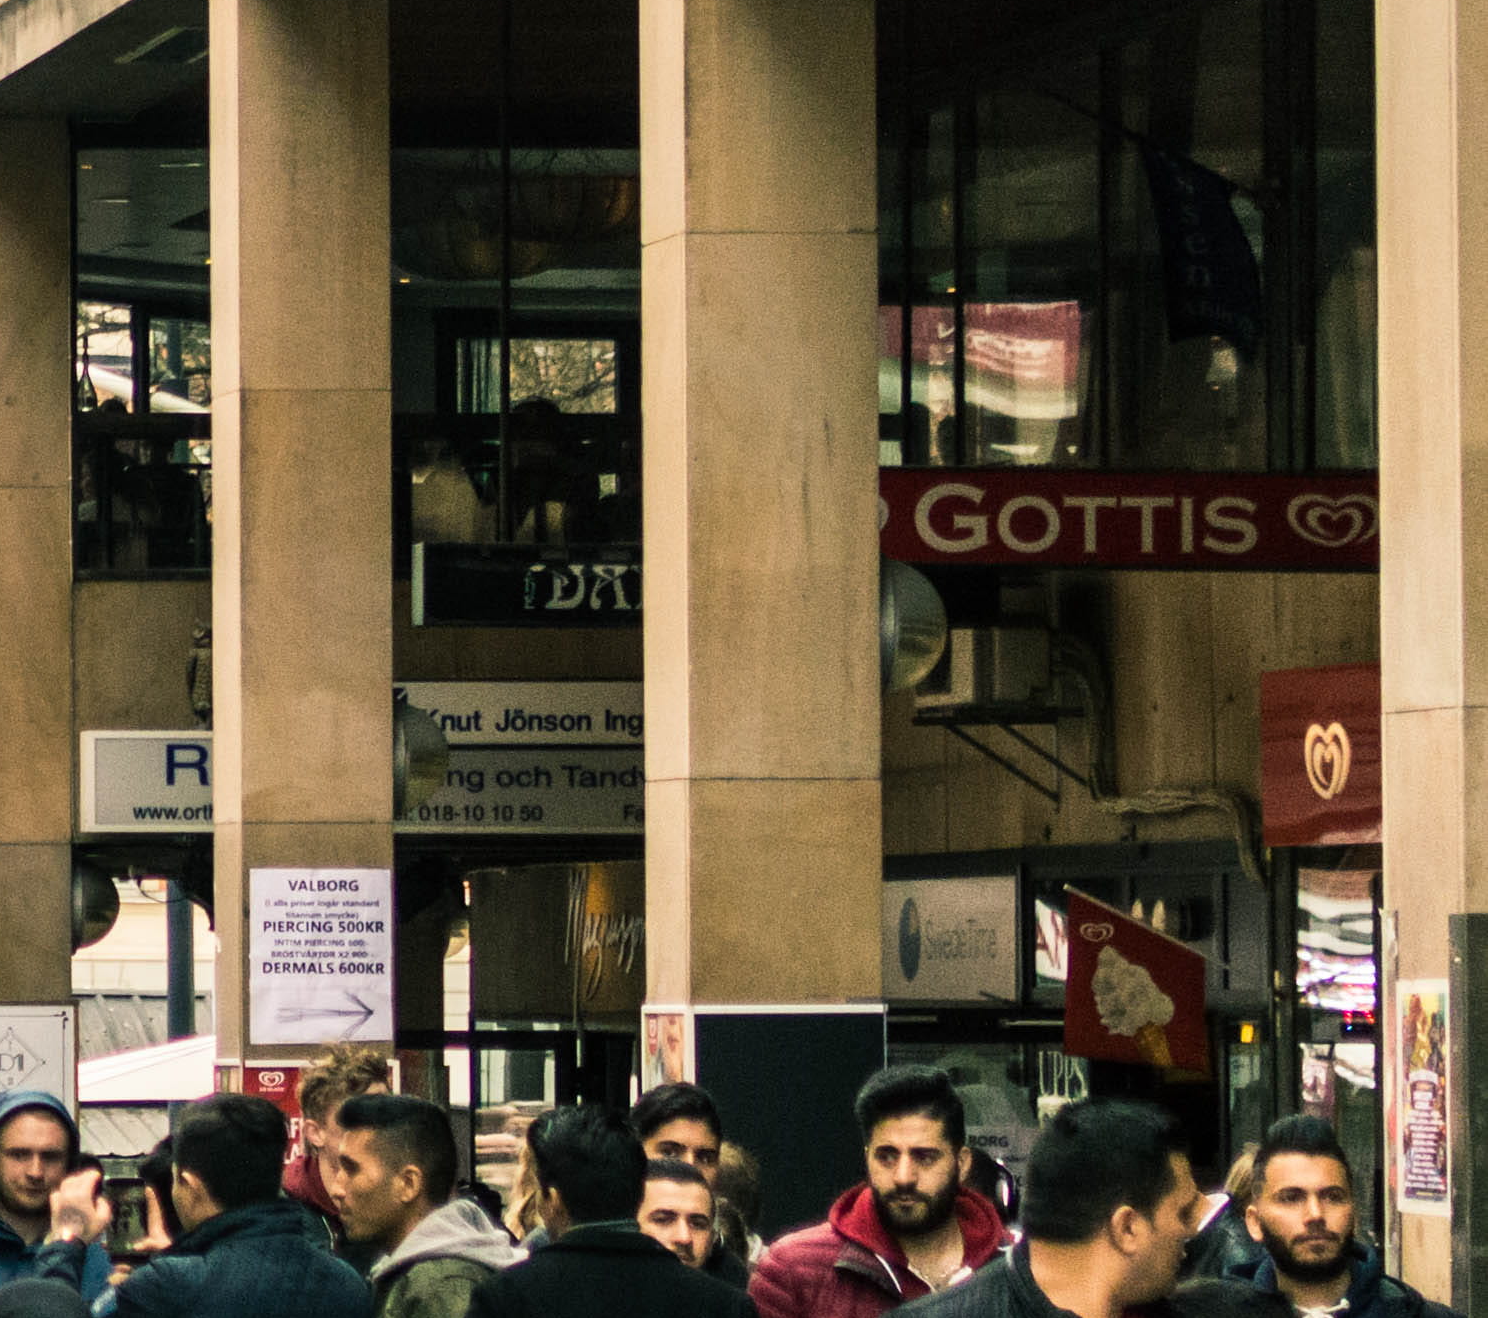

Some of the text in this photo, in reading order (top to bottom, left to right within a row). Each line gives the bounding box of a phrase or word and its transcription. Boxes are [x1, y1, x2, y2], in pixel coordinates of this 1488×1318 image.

[433, 709, 482, 733] nut
[495, 707, 592, 733] Jönson
[446, 768, 485, 793] ng
[496, 766, 552, 788] och
[418, 805, 485, 821] 018-10
[492, 805, 514, 821] 10
[288, 880, 360, 892] VALBORG
[263, 921, 385, 932] PIERCING 500KR
[262, 962, 385, 974] DERMALS 600KR
